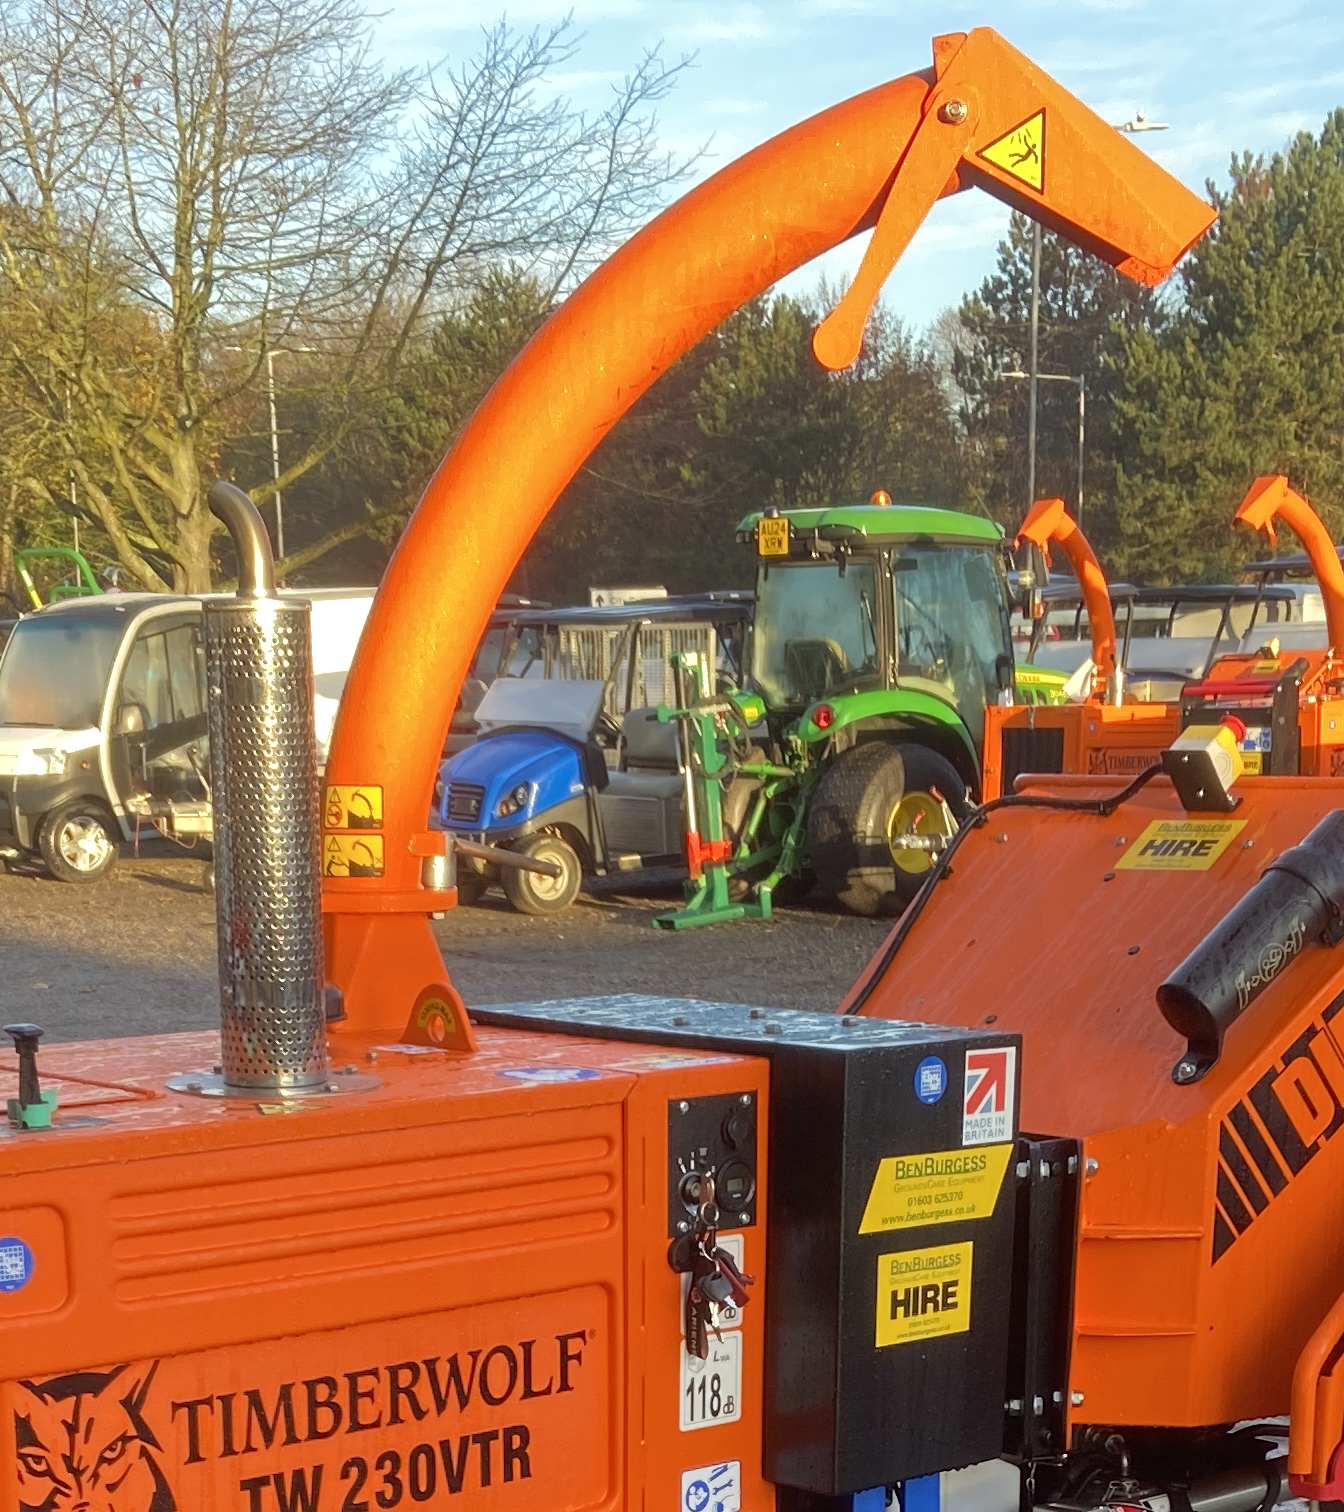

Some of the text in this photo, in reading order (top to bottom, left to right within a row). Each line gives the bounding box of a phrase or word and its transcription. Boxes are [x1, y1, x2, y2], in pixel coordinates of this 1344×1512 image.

[1137, 839, 1220, 857] HIRE
[965, 1116, 1006, 1131] MADE IN
[964, 1128, 1005, 1141] BRITAIN
[907, 1194, 933, 1208] 01603
[890, 1279, 960, 1321] HIRE
[171, 1329, 587, 1466] TIMBERWOLF
[686, 1372, 735, 1422] 118 dB
